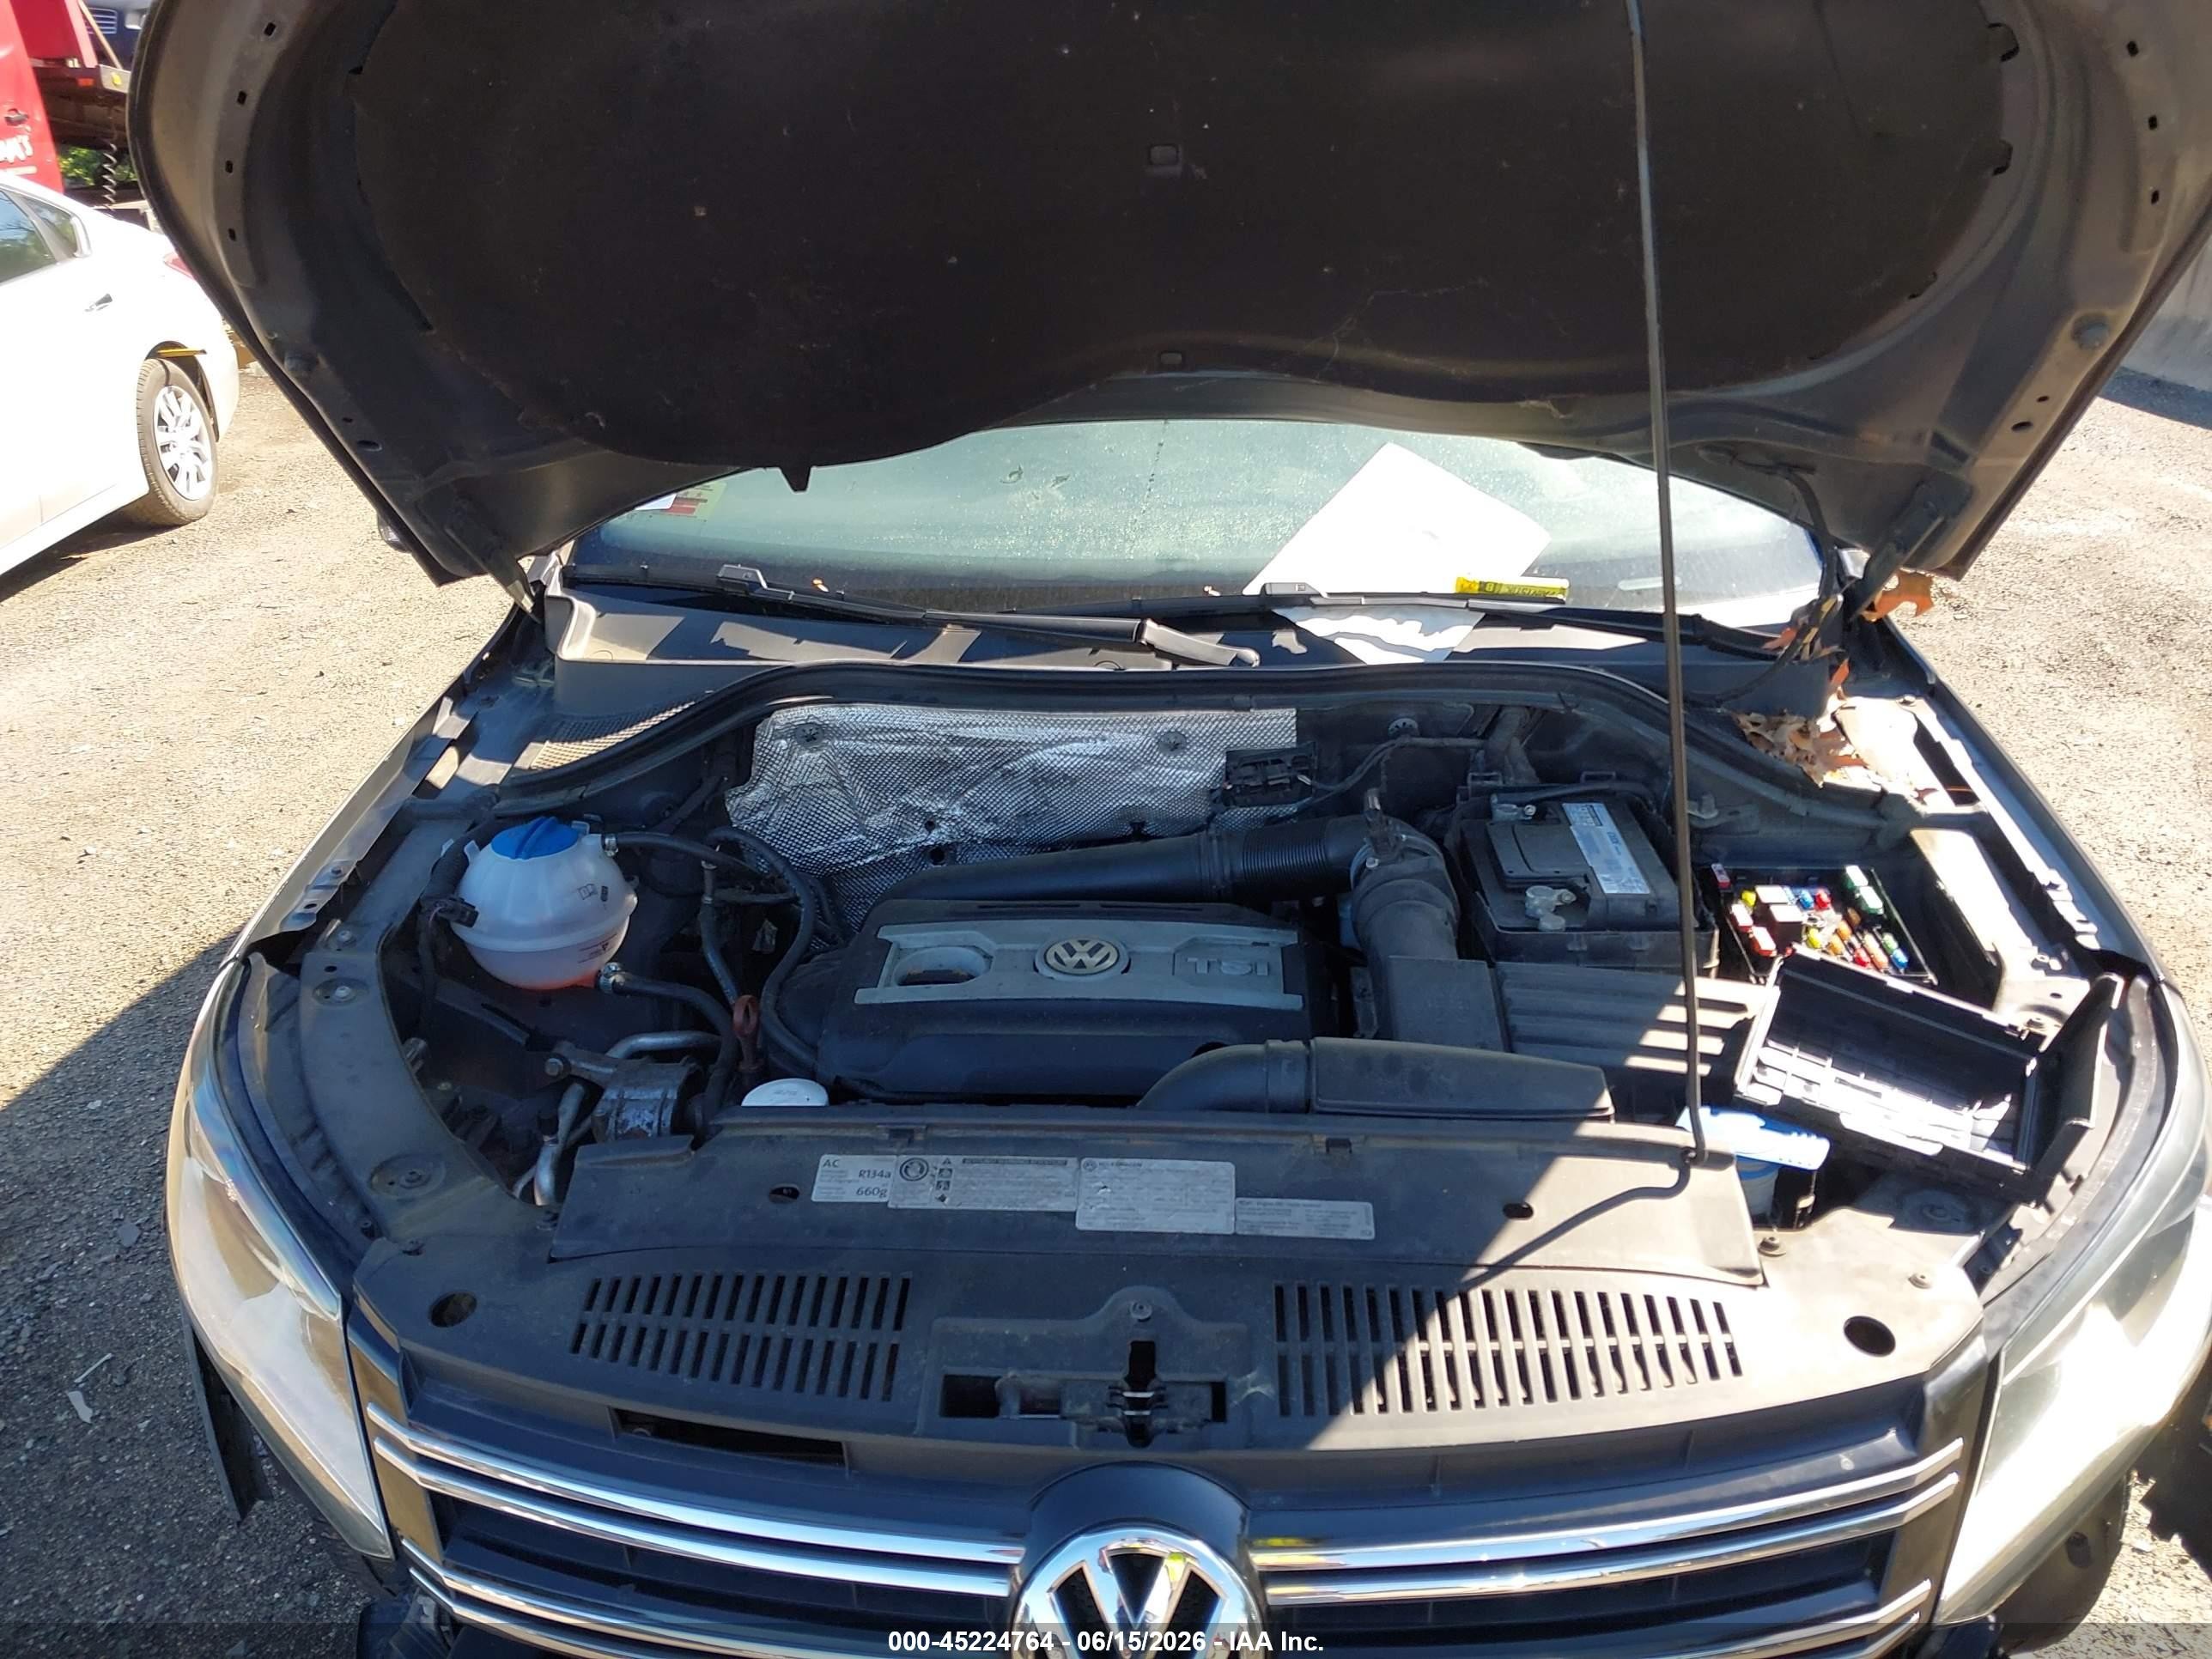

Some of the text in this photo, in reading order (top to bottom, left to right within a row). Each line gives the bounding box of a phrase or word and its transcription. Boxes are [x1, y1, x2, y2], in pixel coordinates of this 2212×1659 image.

[1186, 957, 1270, 976] TSI
[823, 1159, 840, 1168] AC
[859, 1169, 891, 1179] R134a
[856, 1187, 888, 1199] 660g
